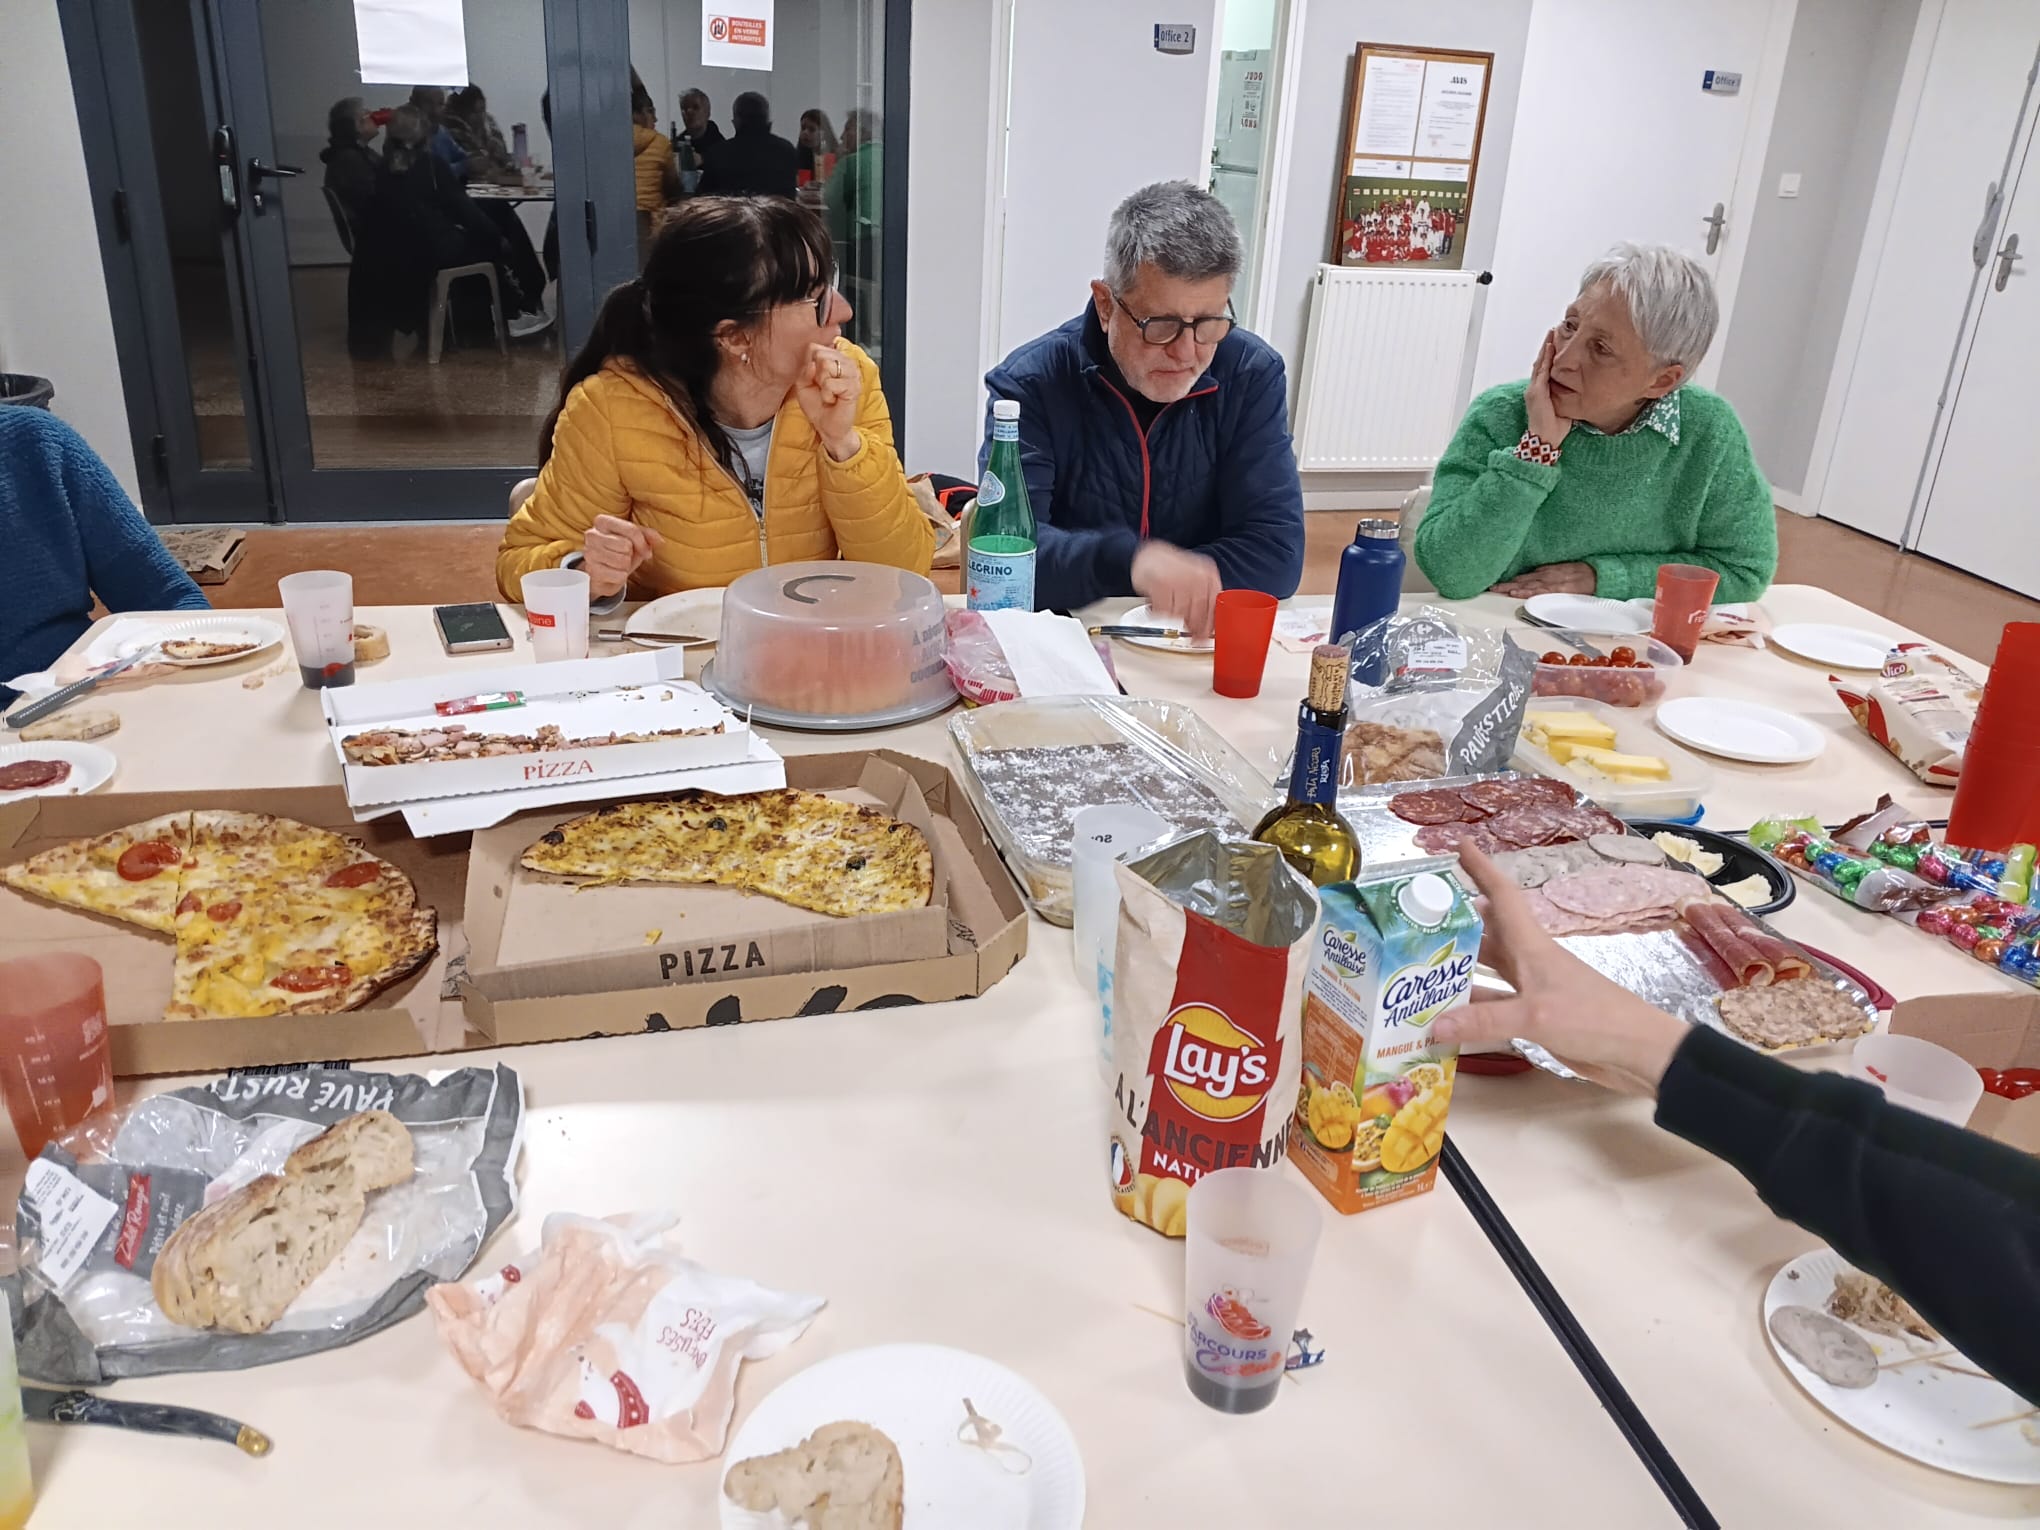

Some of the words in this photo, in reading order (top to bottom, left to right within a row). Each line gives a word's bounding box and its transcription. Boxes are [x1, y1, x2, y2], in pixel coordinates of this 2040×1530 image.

[731, 20, 762, 28] BOUTEILLES
[731, 34, 761, 42] INTERDITES
[1160, 29, 1181, 42] Office
[1184, 31, 1190, 42] 2
[969, 559, 1012, 575] LEGRINO
[659, 941, 765, 979] PIZZA
[1323, 929, 1367, 965] Caresse
[1323, 949, 1367, 977] Antillaise
[1382, 954, 1473, 1010] Caresse
[1383, 976, 1469, 1029] Antillaise
[1164, 1022, 1267, 1099] Lay's
[1376, 1041, 1413, 1058] MANGUE
[1416, 1038, 1422, 1049] &
[1425, 1035, 1441, 1048] PA
[309, 1081, 395, 1113] PAVÉ
